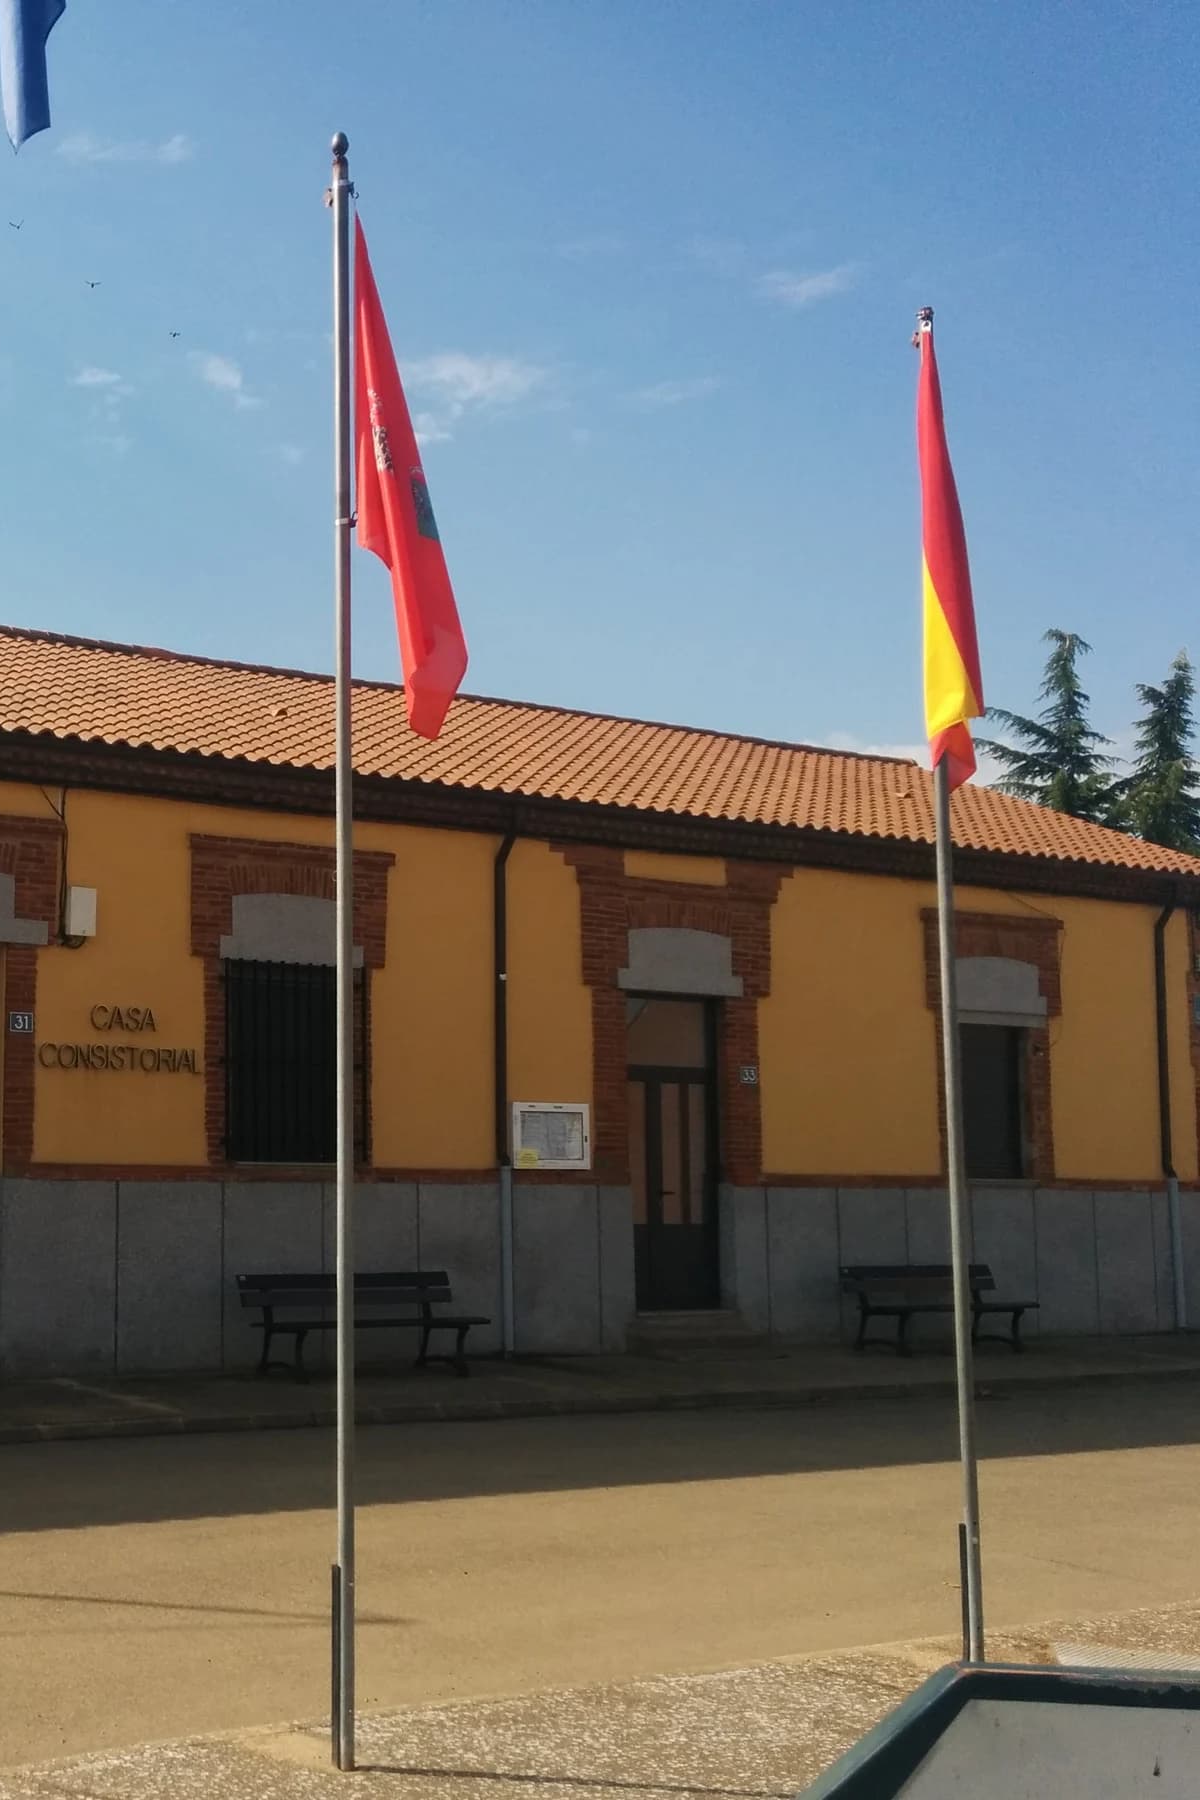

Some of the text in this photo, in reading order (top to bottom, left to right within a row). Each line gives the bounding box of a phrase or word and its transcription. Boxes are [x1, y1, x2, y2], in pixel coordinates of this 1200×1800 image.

[14, 1015, 29, 1030] 31
[90, 1004, 156, 1032] CASA
[38, 1042, 203, 1074] CONSISTORIAL
